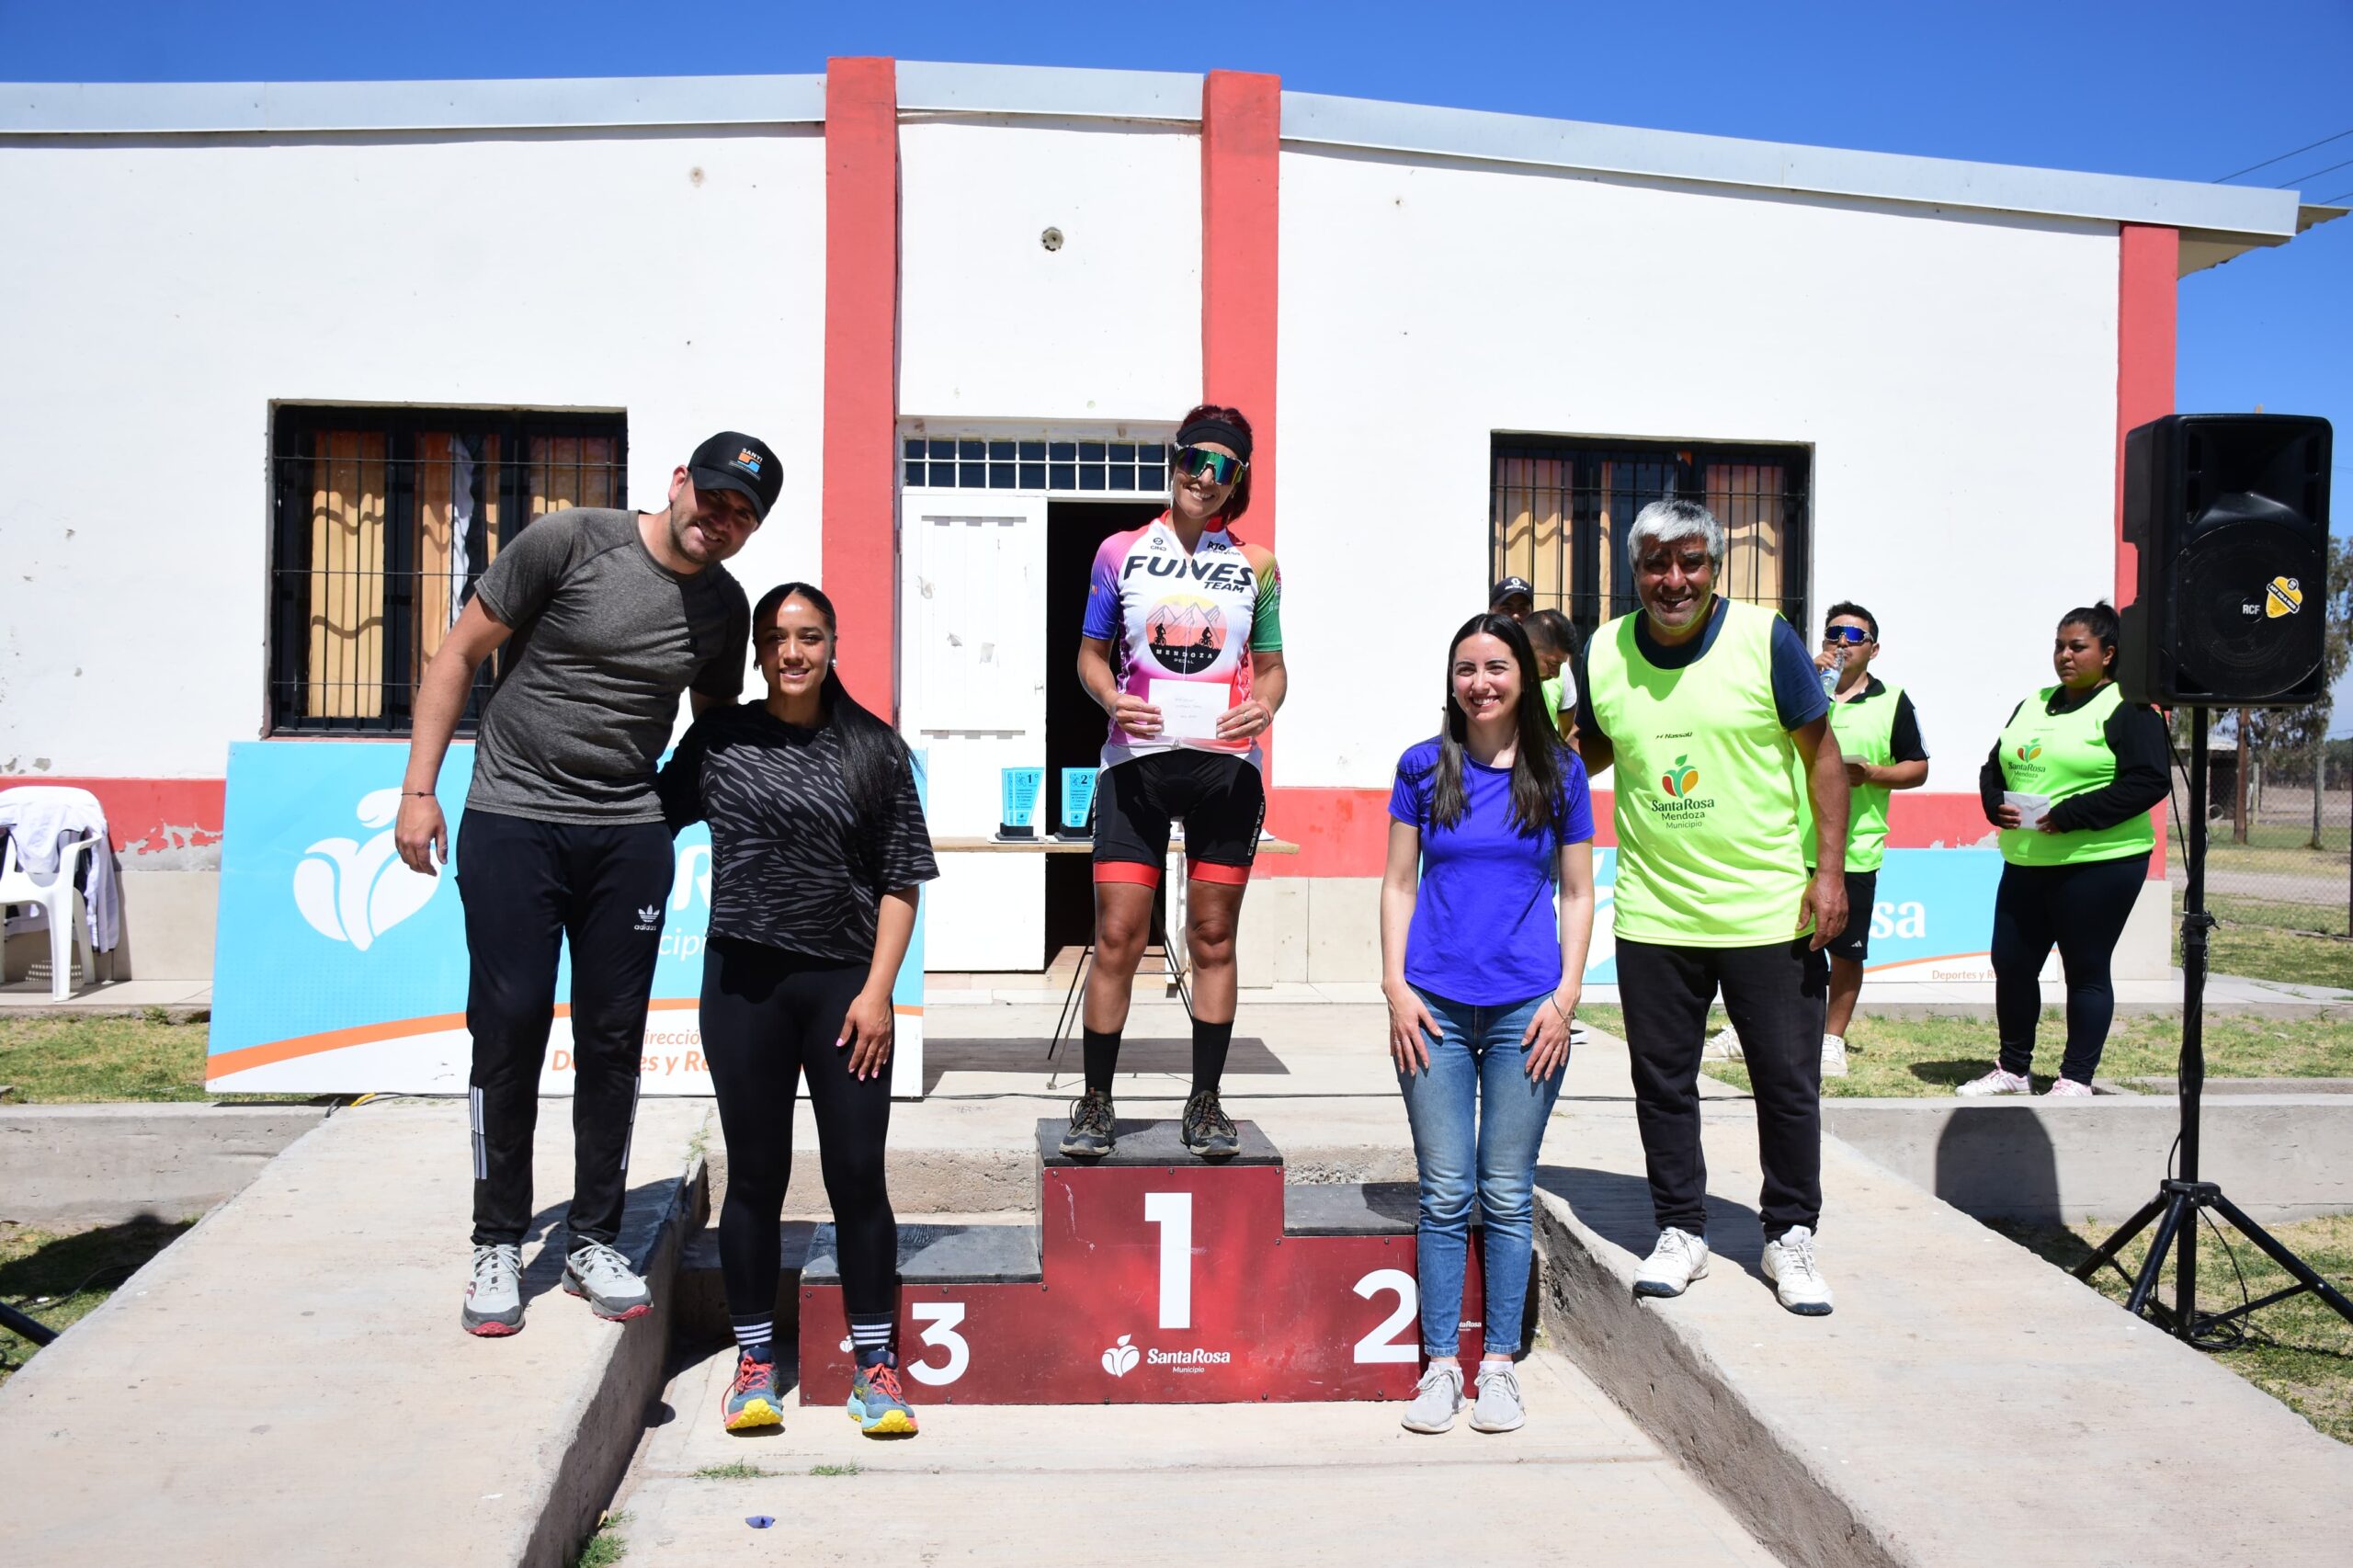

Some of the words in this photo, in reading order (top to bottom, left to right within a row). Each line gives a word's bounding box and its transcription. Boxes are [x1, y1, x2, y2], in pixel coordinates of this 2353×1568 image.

[1123, 555, 1254, 586] FUNES
[1203, 581, 1245, 594] TEAM
[2243, 604, 2261, 615] RCF
[1155, 649, 1212, 659] MENDOZA
[1661, 811, 1706, 821] Mendoza
[1665, 820, 1703, 829] Municipio
[1932, 970, 1977, 982] Deportes
[644, 1028, 701, 1045] irecció
[665, 1056, 678, 1076] y
[1144, 1192, 1192, 1329] 1
[1353, 1268, 1420, 1364] 2
[907, 1302, 970, 1386] 3
[1147, 1347, 1231, 1364] SantaRosa
[1172, 1366, 1205, 1374] Municipio
